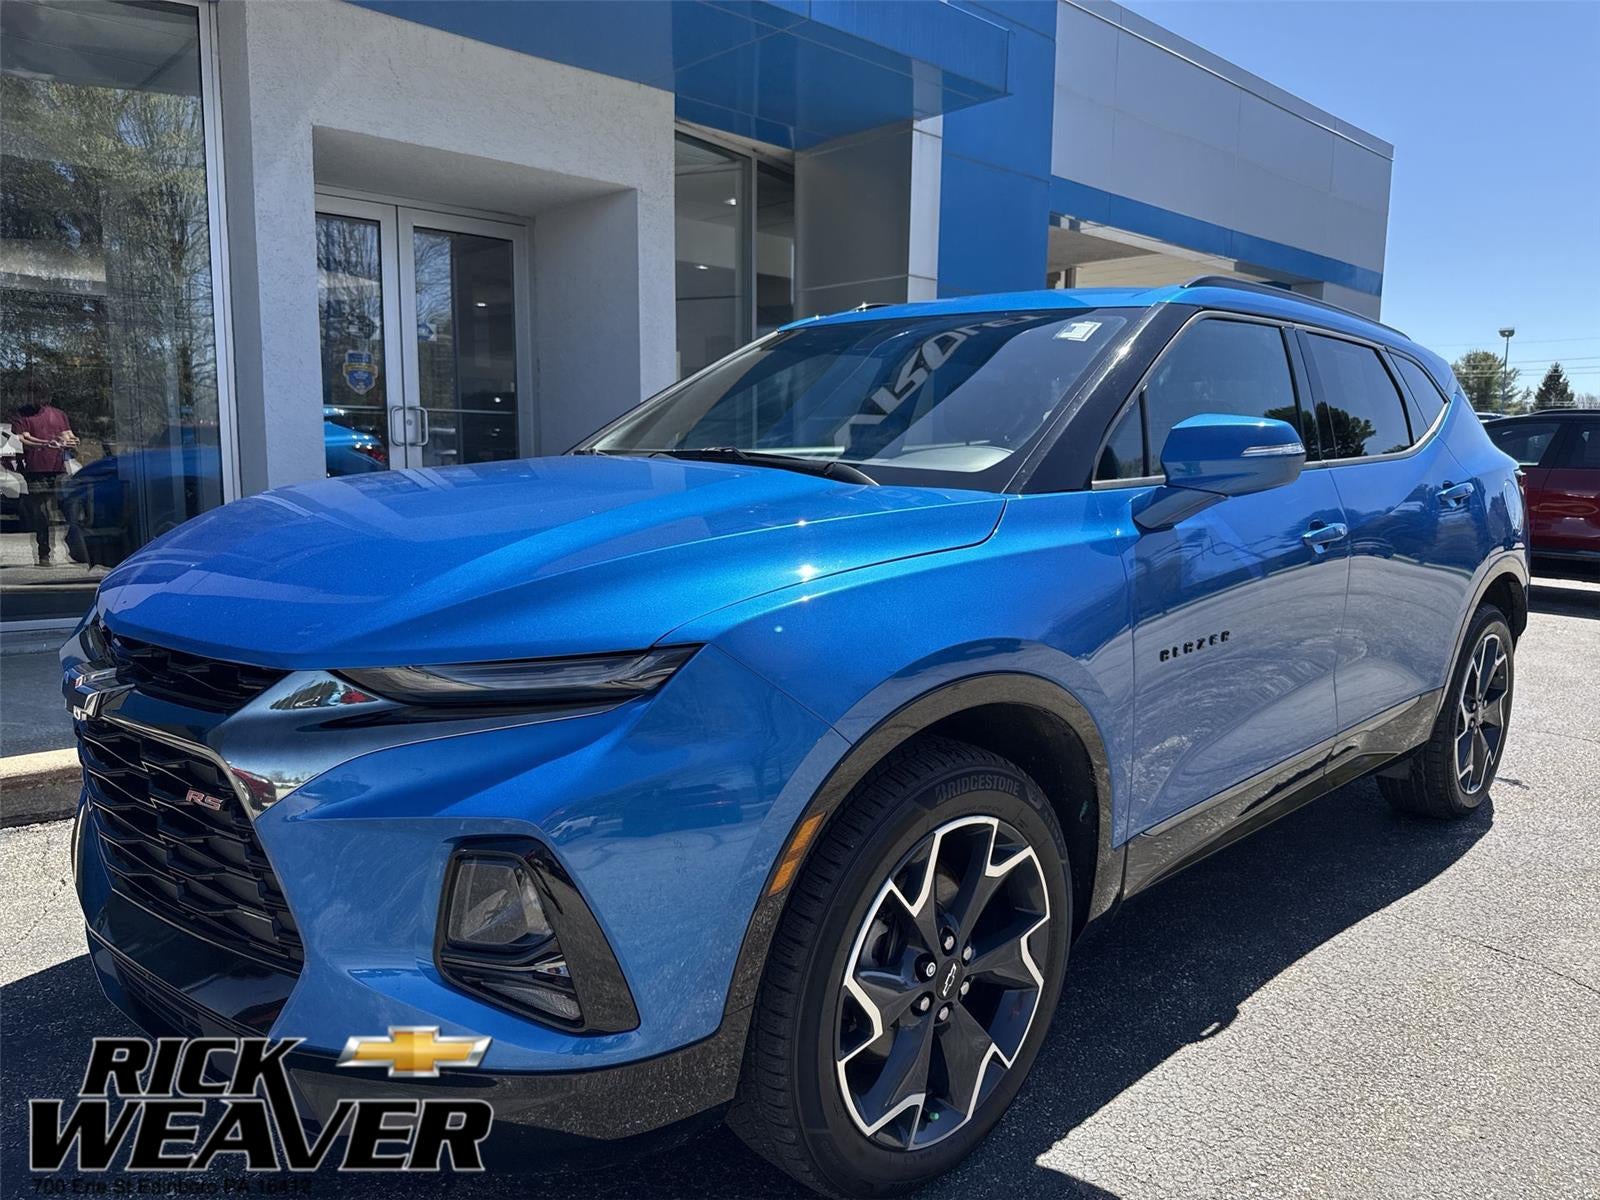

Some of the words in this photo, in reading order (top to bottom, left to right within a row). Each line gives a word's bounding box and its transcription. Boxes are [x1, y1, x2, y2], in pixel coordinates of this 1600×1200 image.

[1160, 630, 1231, 662] BLAZER
[185, 788, 223, 811] RS
[934, 773, 1021, 804] BRIDGESTONE
